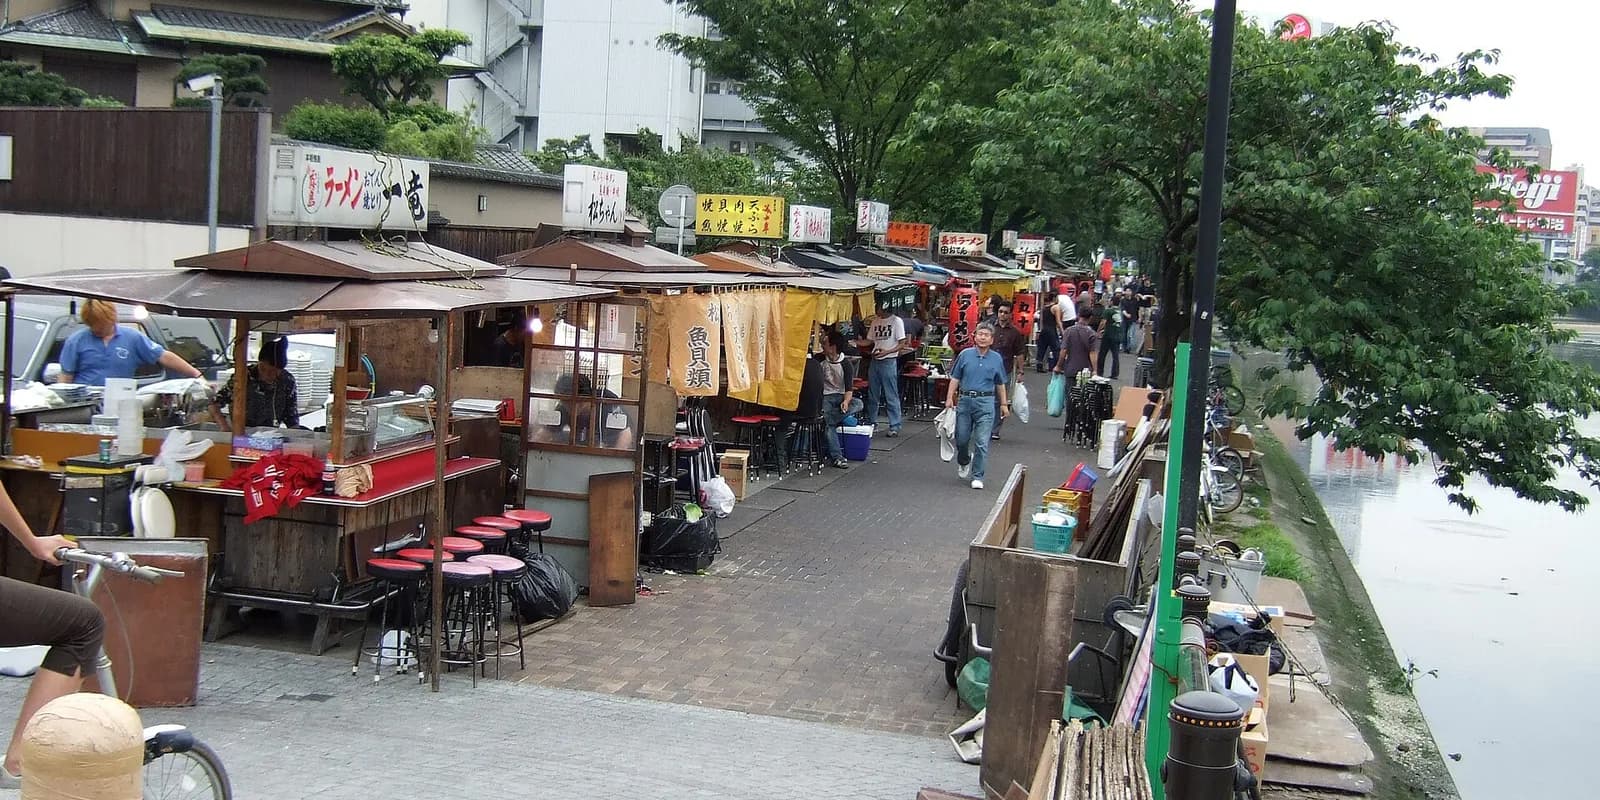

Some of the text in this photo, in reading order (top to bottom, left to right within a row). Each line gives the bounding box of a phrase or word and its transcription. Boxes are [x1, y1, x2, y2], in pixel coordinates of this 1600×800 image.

[324, 166, 363, 210] ラーメン
[382, 169, 425, 221] 一竜
[588, 193, 618, 225] 松ちゃん
[748, 199, 760, 234] 天ぷら
[859, 202, 869, 229] ラーメン
[940, 235, 984, 246] 長浜ラーメン
[1027, 253, 1040, 268] 司
[954, 293, 971, 346] ラーメン
[687, 326, 712, 388] 魚貝類
